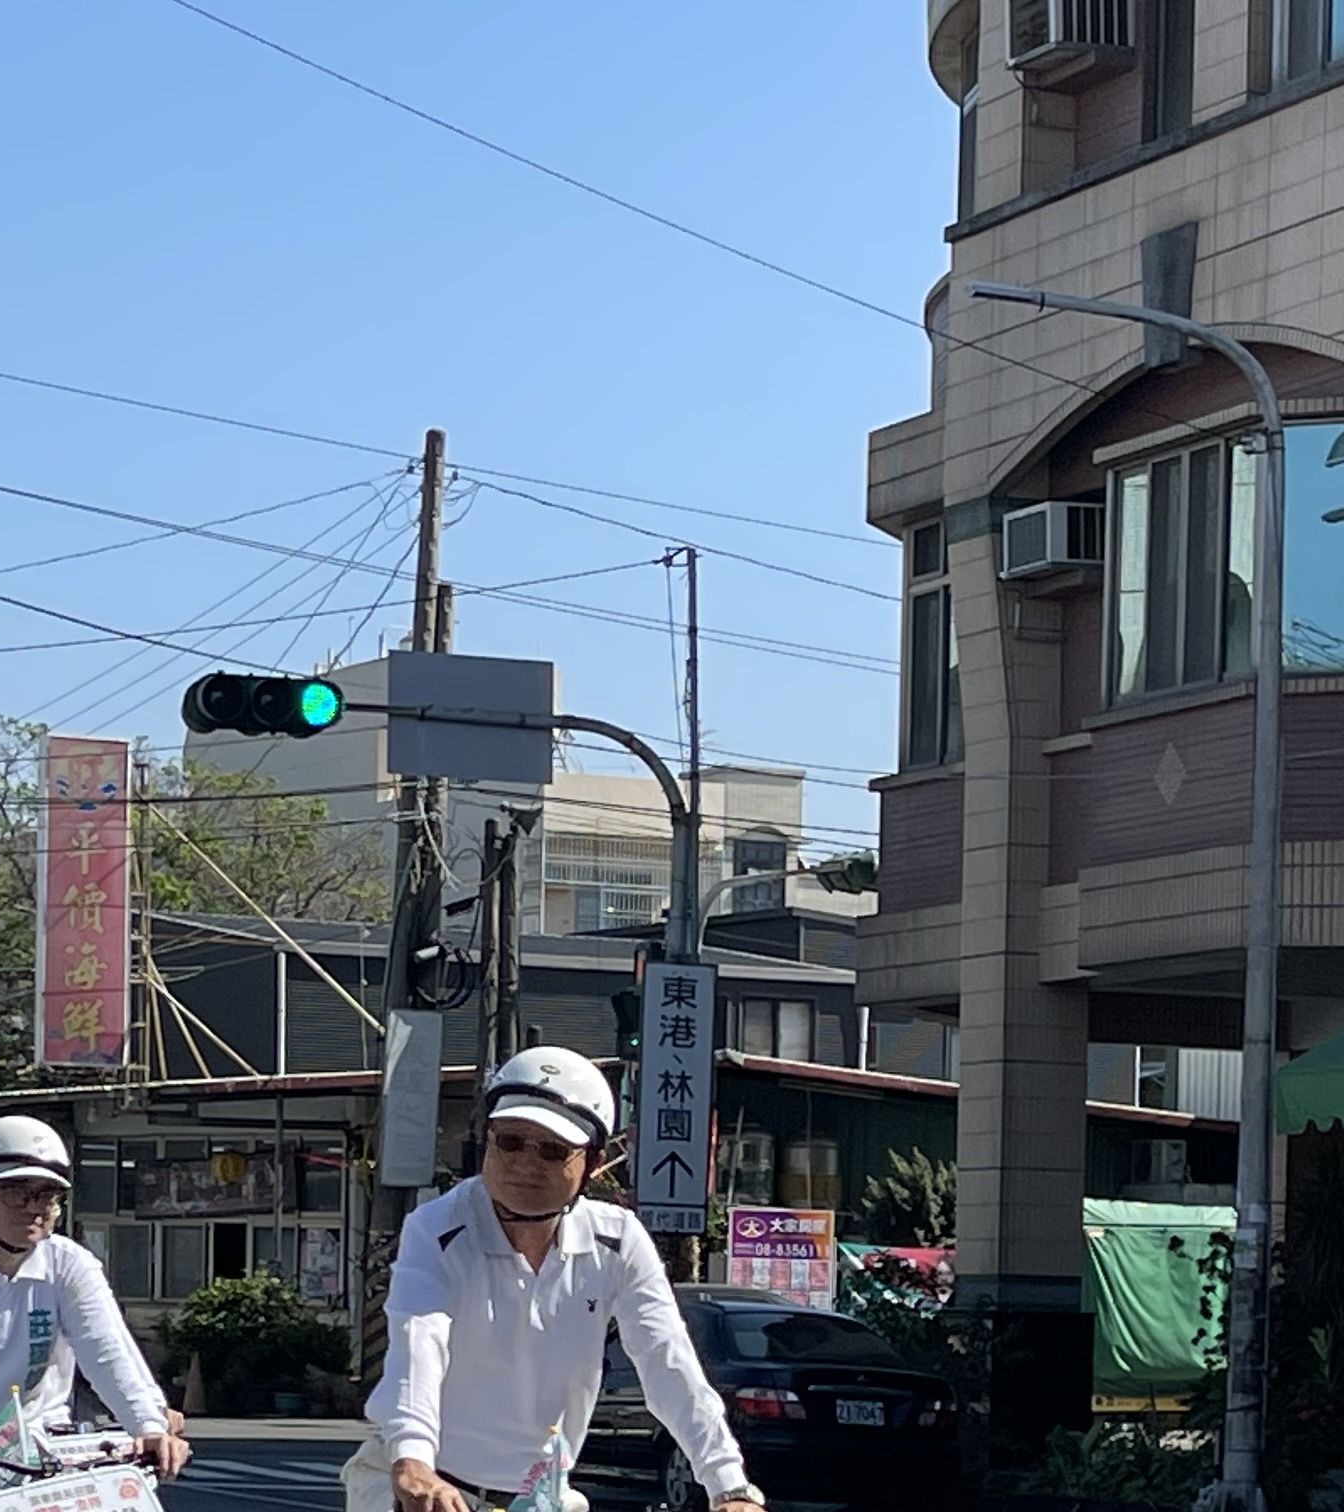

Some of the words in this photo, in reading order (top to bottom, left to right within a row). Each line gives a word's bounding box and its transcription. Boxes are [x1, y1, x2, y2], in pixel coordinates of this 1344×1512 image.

[62, 820, 109, 1052] 平價海鮮
[657, 974, 699, 1142] 東港、林園
